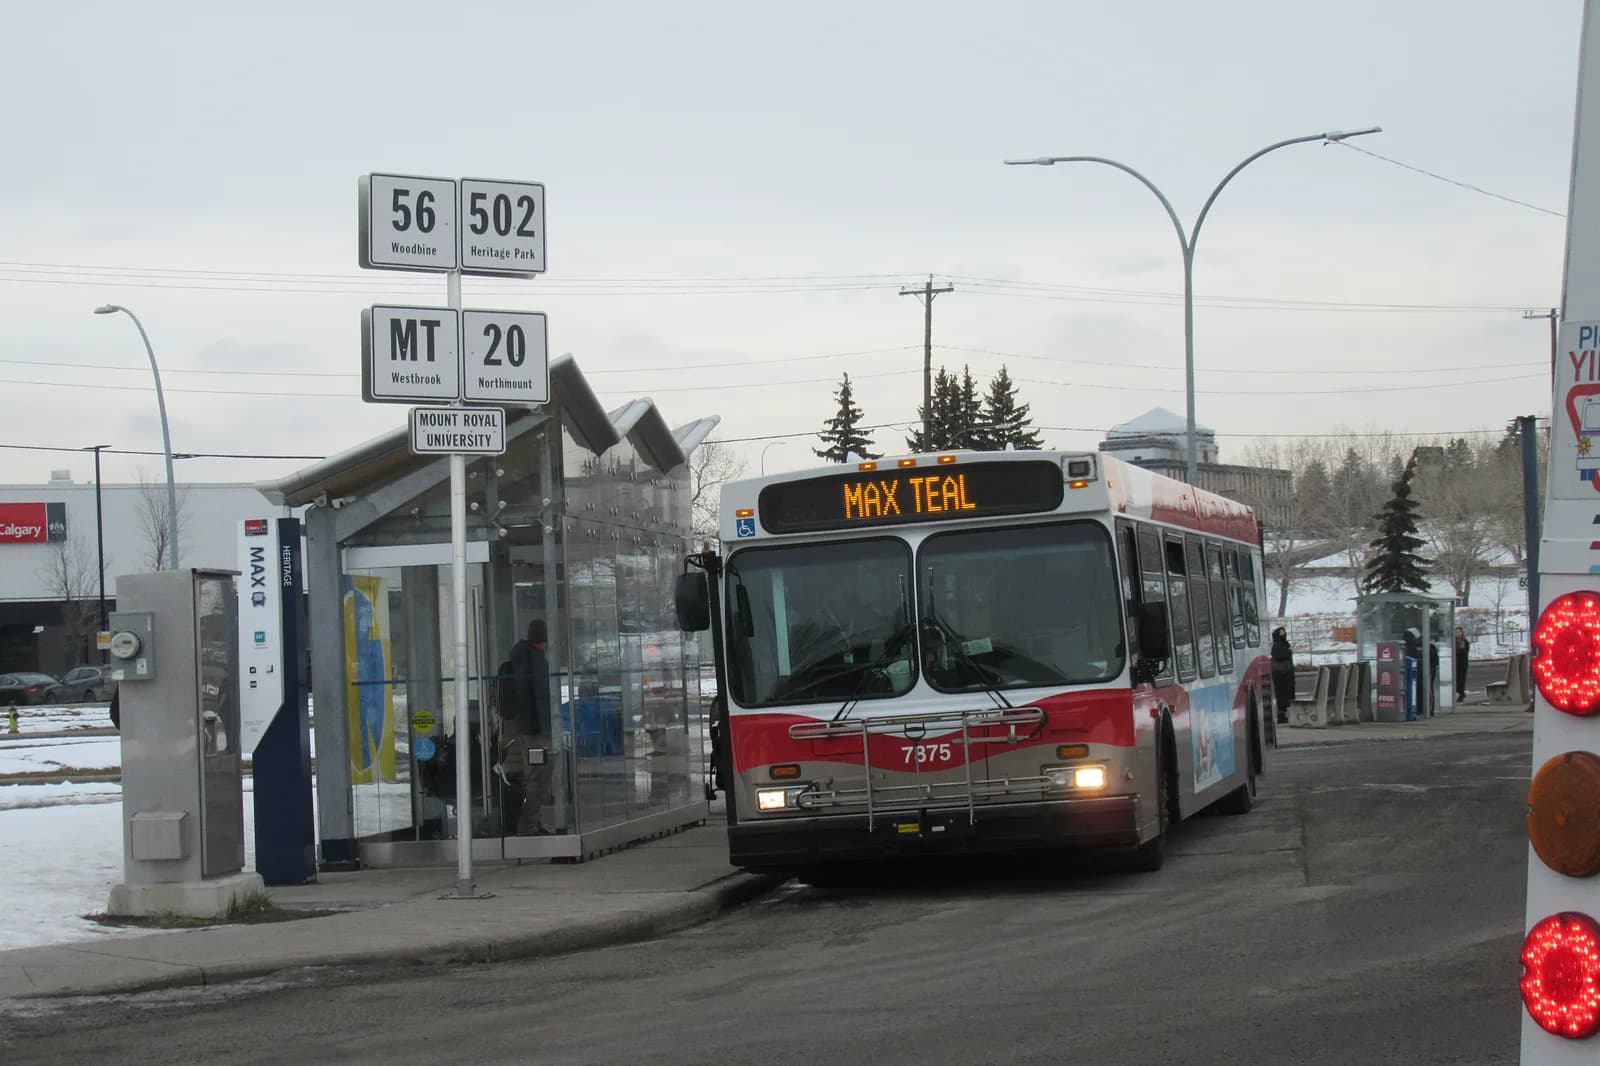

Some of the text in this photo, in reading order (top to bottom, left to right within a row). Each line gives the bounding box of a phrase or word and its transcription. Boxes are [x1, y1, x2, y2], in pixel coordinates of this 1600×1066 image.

[392, 188, 436, 233] 56
[469, 192, 535, 237] 502
[391, 241, 437, 256] Woodbine
[471, 245, 535, 260] Heritage Park
[390, 318, 441, 362] MT
[483, 323, 526, 367] 20
[1579, 325, 1600, 349] Pl
[391, 371, 441, 385] Westbrook
[478, 377, 533, 390] Northmount
[419, 413, 498, 427] MOUNT ROYAL
[426, 433, 492, 447] UNIVERSITY
[844, 474, 977, 519] MAX TEAL
[249, 546, 266, 588] MAX
[282, 545, 292, 588] HERITAGE
[901, 743, 952, 764] 7875
